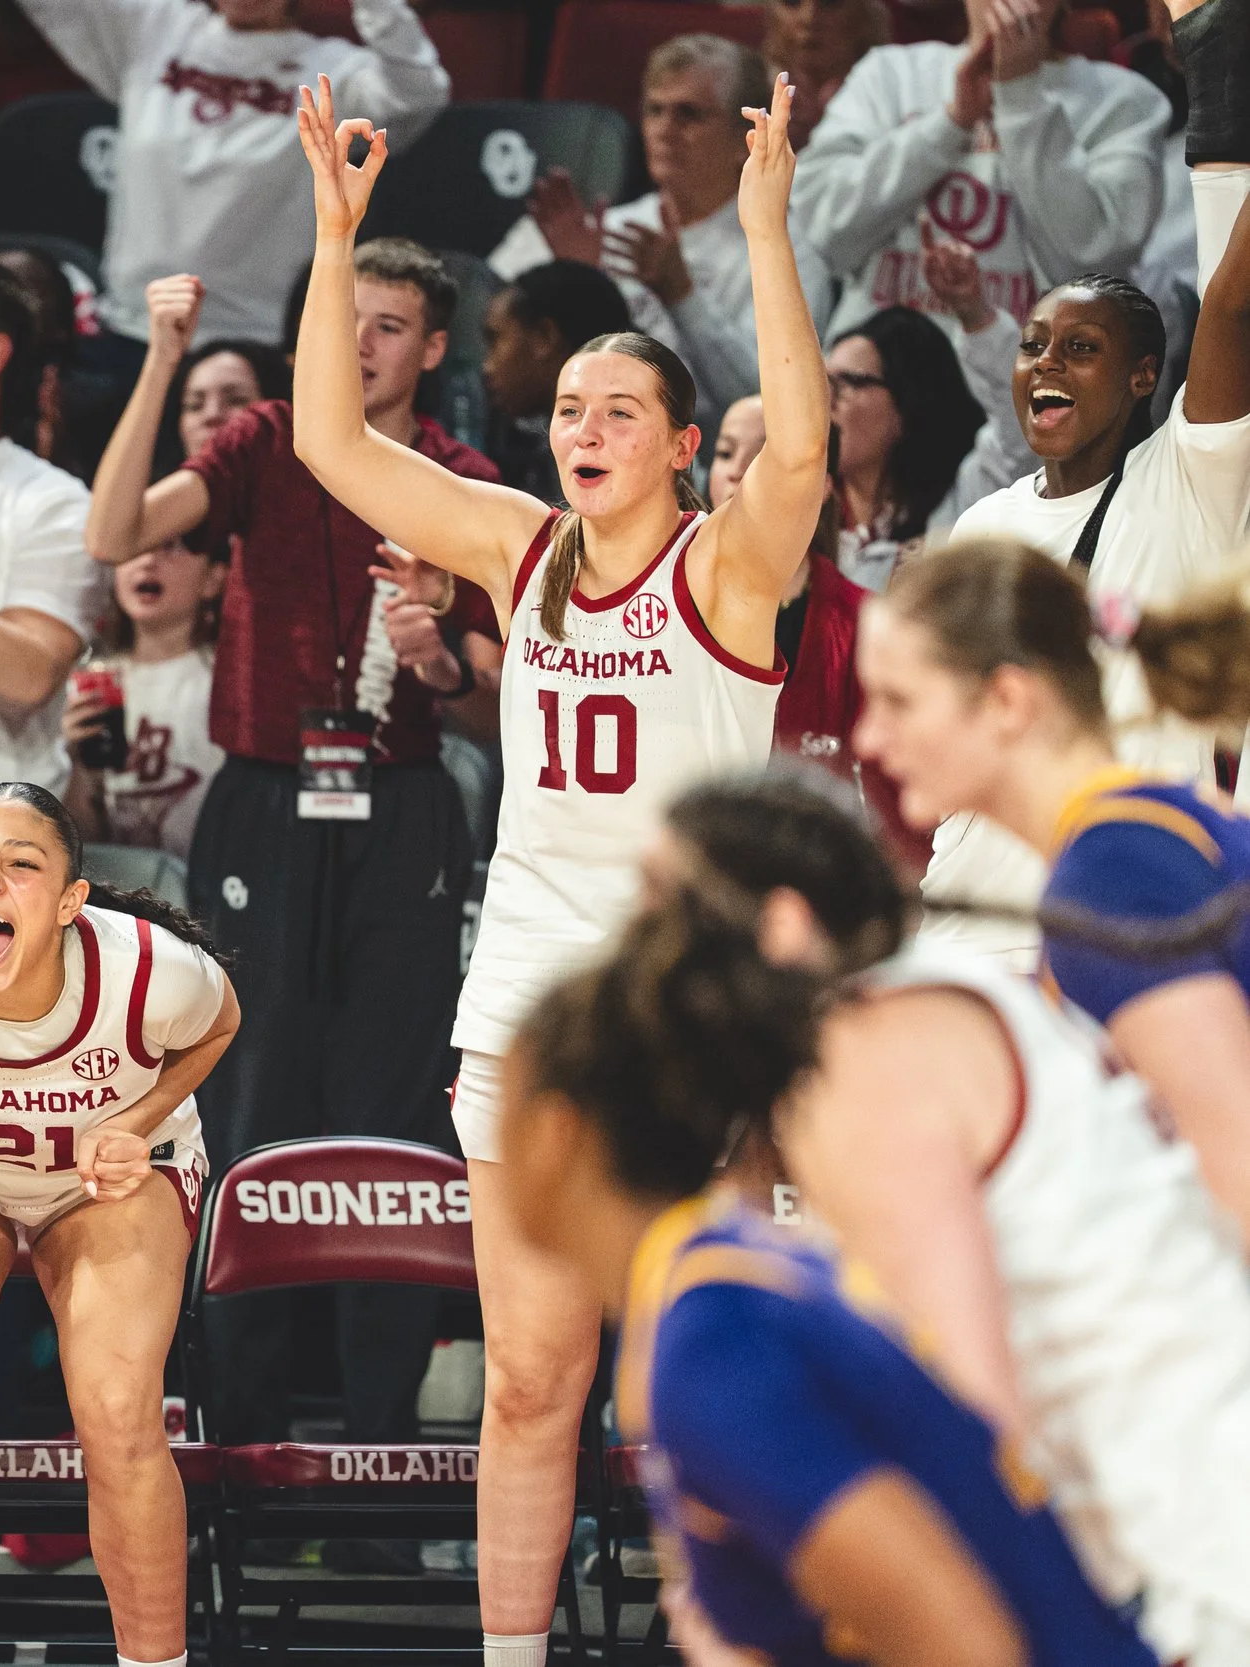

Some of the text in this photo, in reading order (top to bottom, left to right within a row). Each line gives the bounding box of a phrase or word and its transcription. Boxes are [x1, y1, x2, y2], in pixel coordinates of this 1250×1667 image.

[924, 171, 1013, 252] OU
[623, 593, 668, 638] SEC
[524, 637, 672, 679] OKLAHOMA
[538, 689, 637, 794] 10
[72, 1048, 119, 1080] SEC
[236, 1180, 472, 1226] SOONERS
